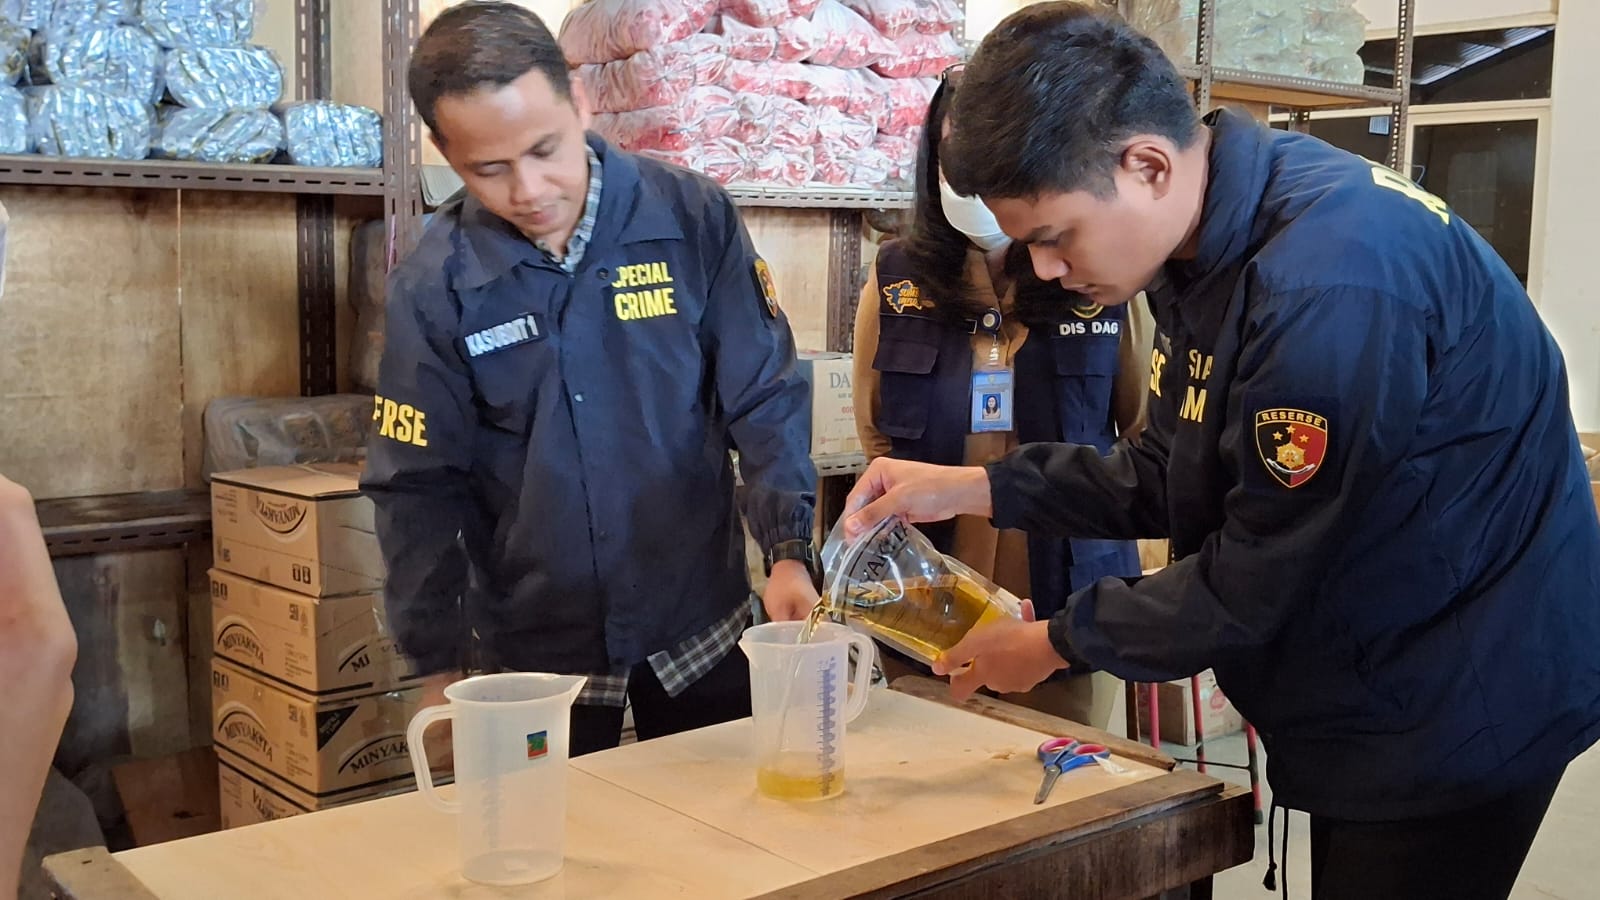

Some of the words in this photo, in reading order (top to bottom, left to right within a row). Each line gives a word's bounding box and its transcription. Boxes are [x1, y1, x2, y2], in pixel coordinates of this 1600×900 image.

[614, 287, 678, 321] CRIME
[1059, 322, 1086, 336] DIS
[1091, 321, 1119, 335] DAG
[1180, 386, 1207, 423] M
[1261, 411, 1322, 427] RESERSE
